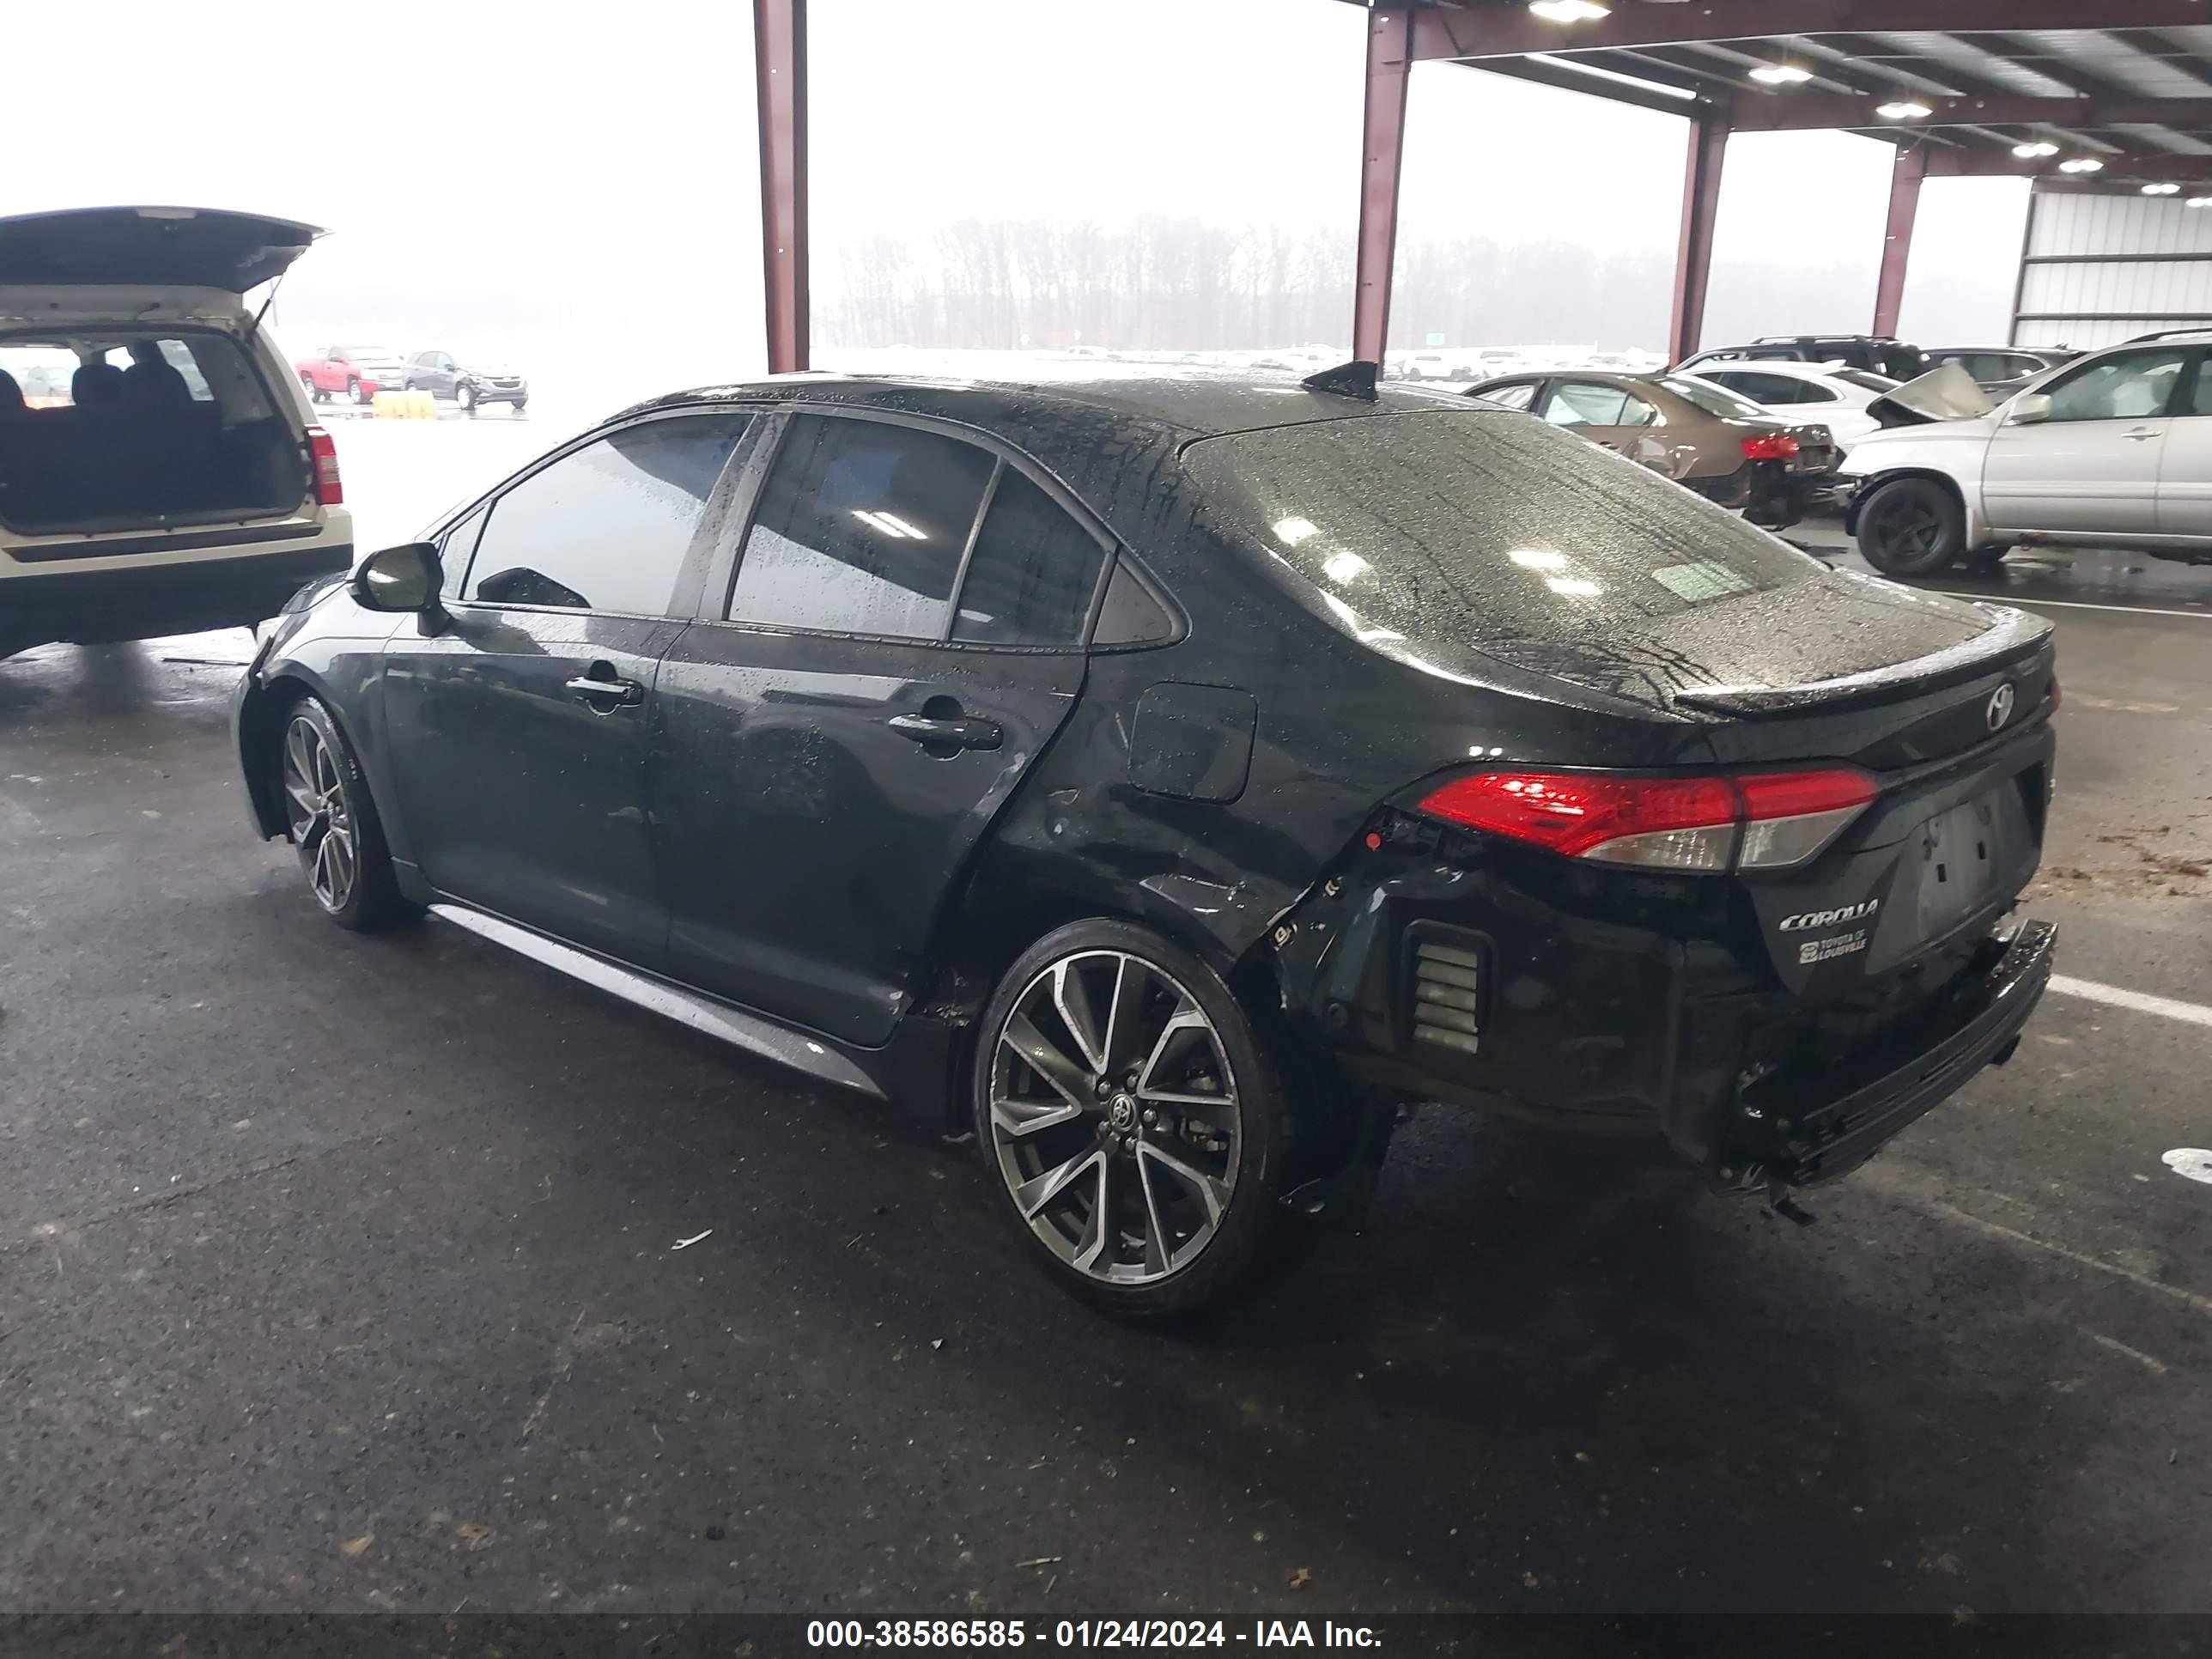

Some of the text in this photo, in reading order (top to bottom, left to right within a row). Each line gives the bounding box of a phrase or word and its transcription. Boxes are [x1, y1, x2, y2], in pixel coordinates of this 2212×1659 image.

[1778, 898, 1879, 931] COROLLA
[1819, 939, 1867, 960] LOUISVILLE
[1820, 933, 1853, 949] TOYOTA
